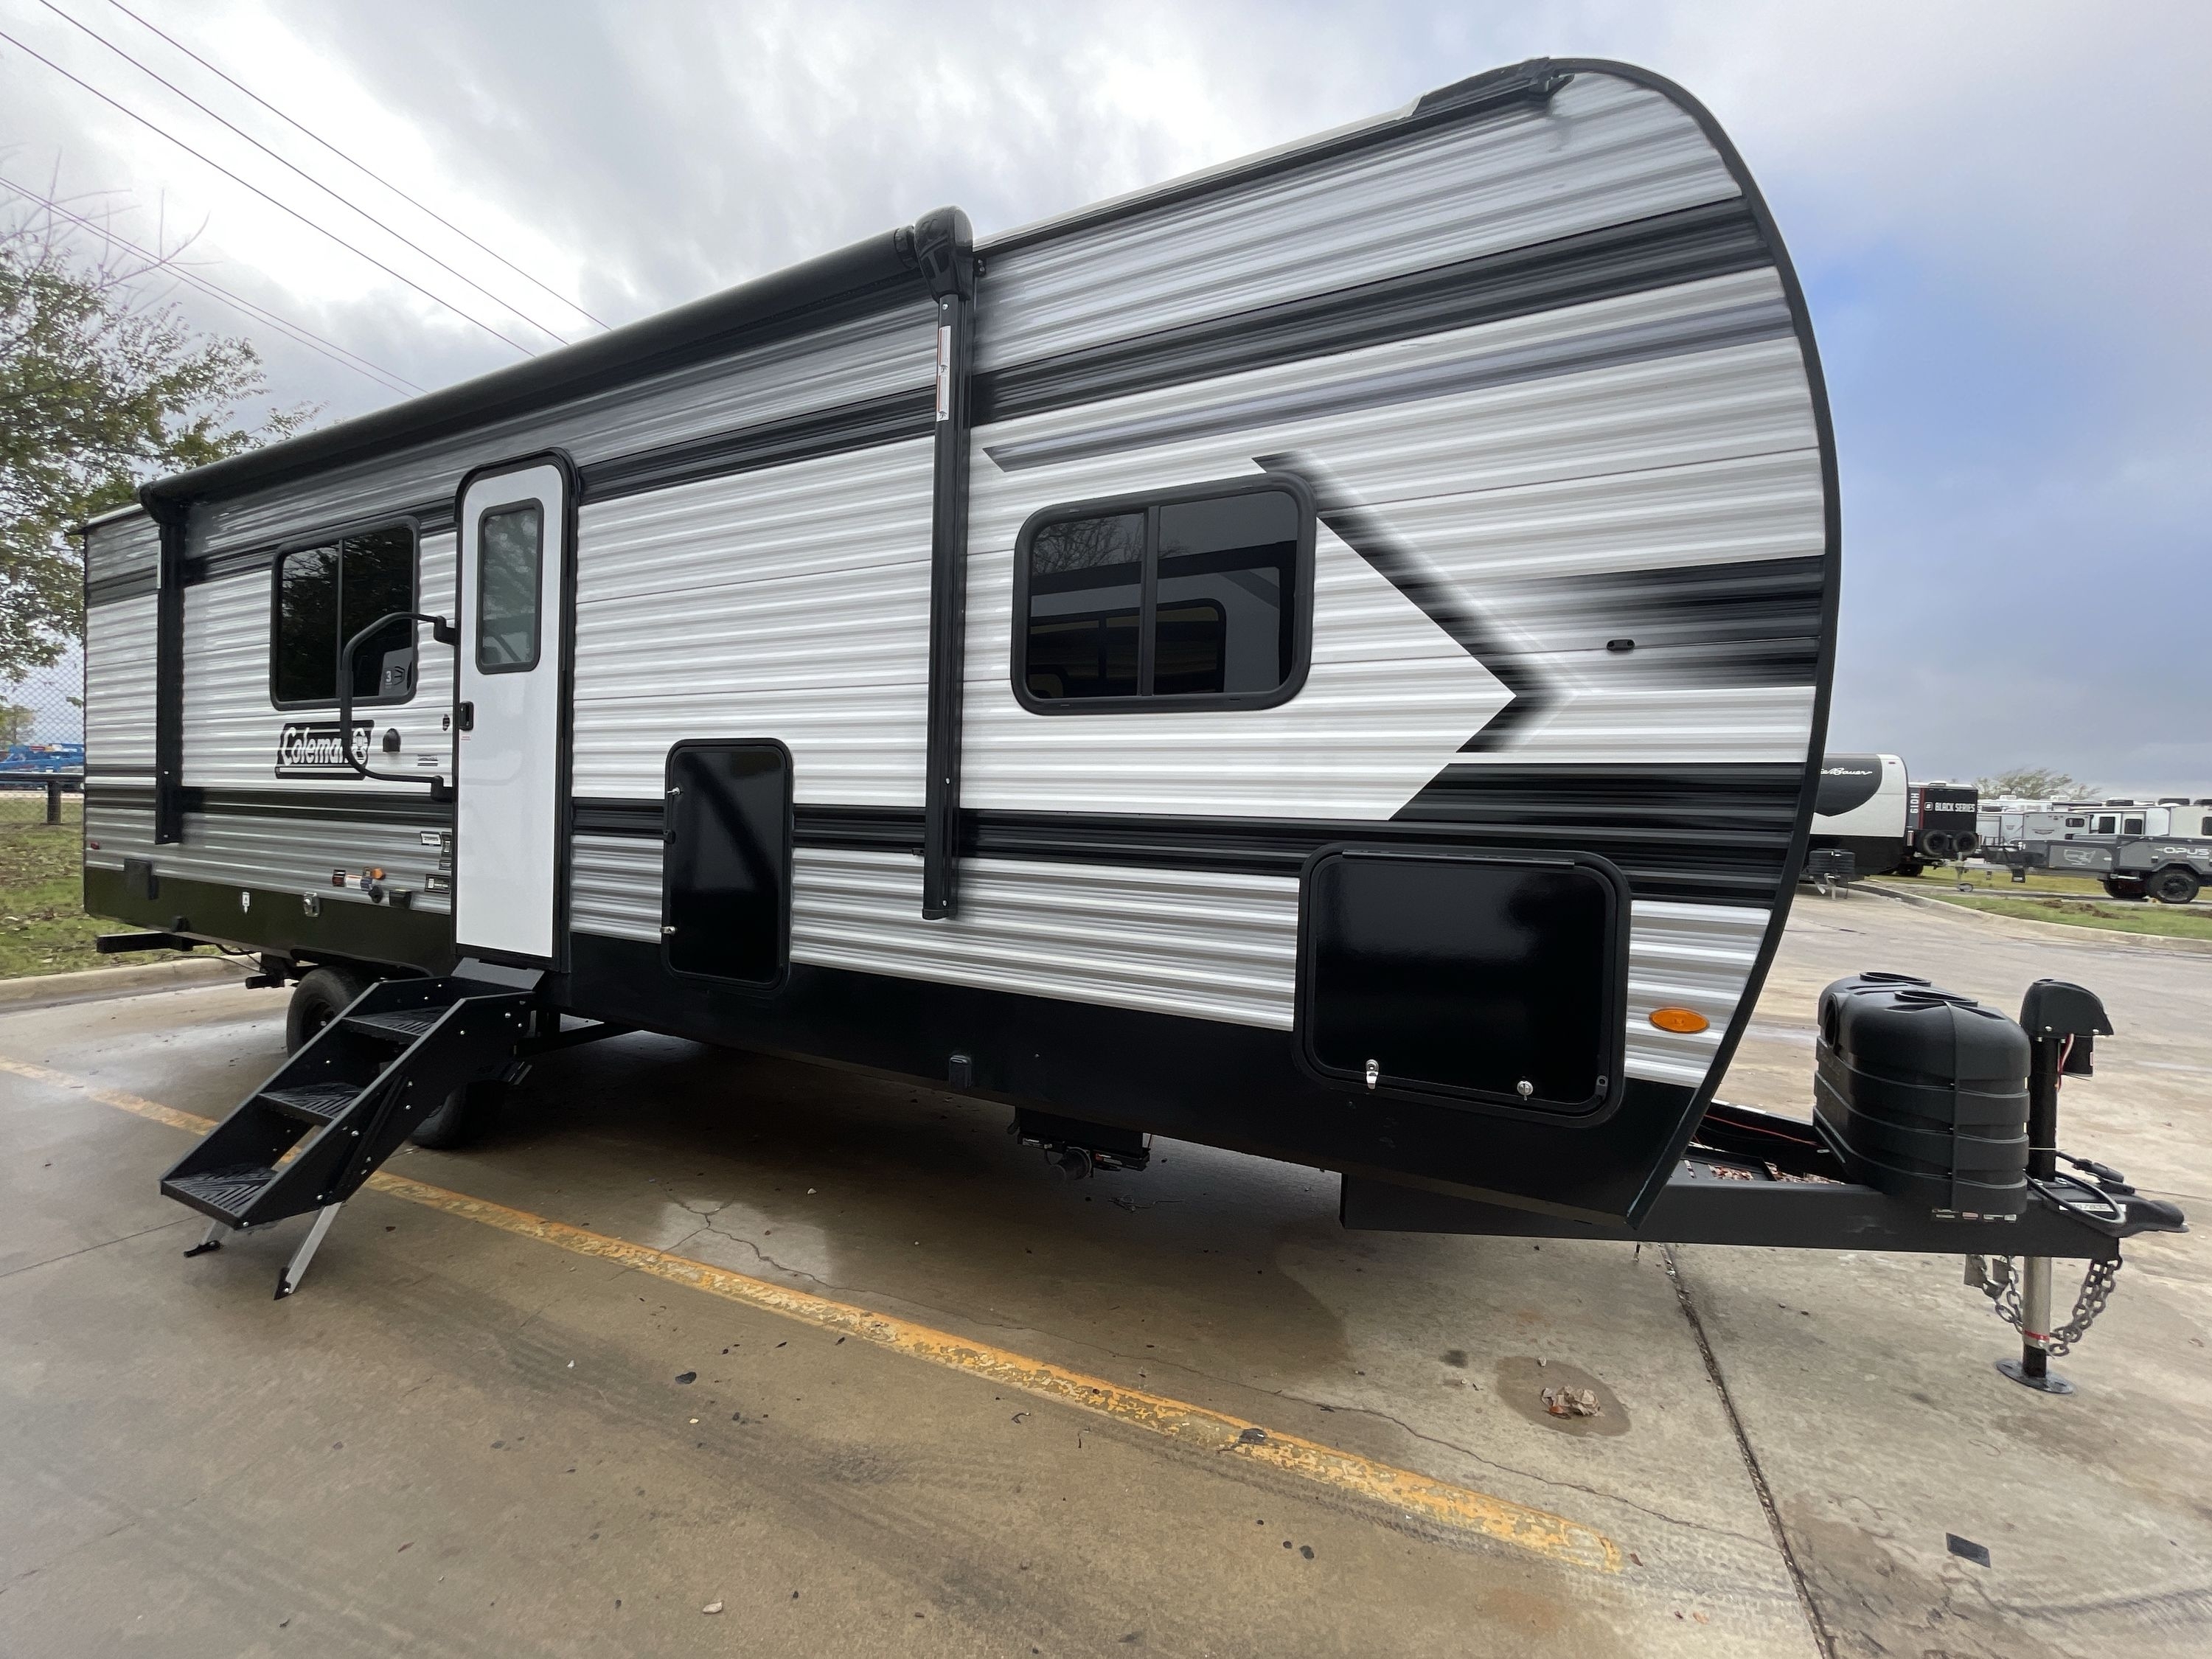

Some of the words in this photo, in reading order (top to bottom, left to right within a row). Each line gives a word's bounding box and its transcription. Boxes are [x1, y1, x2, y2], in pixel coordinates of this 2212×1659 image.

[1935, 802, 1954, 812] BLACK
[1955, 803, 1975, 813] SERIES
[2163, 846, 2210, 855] OPUS
